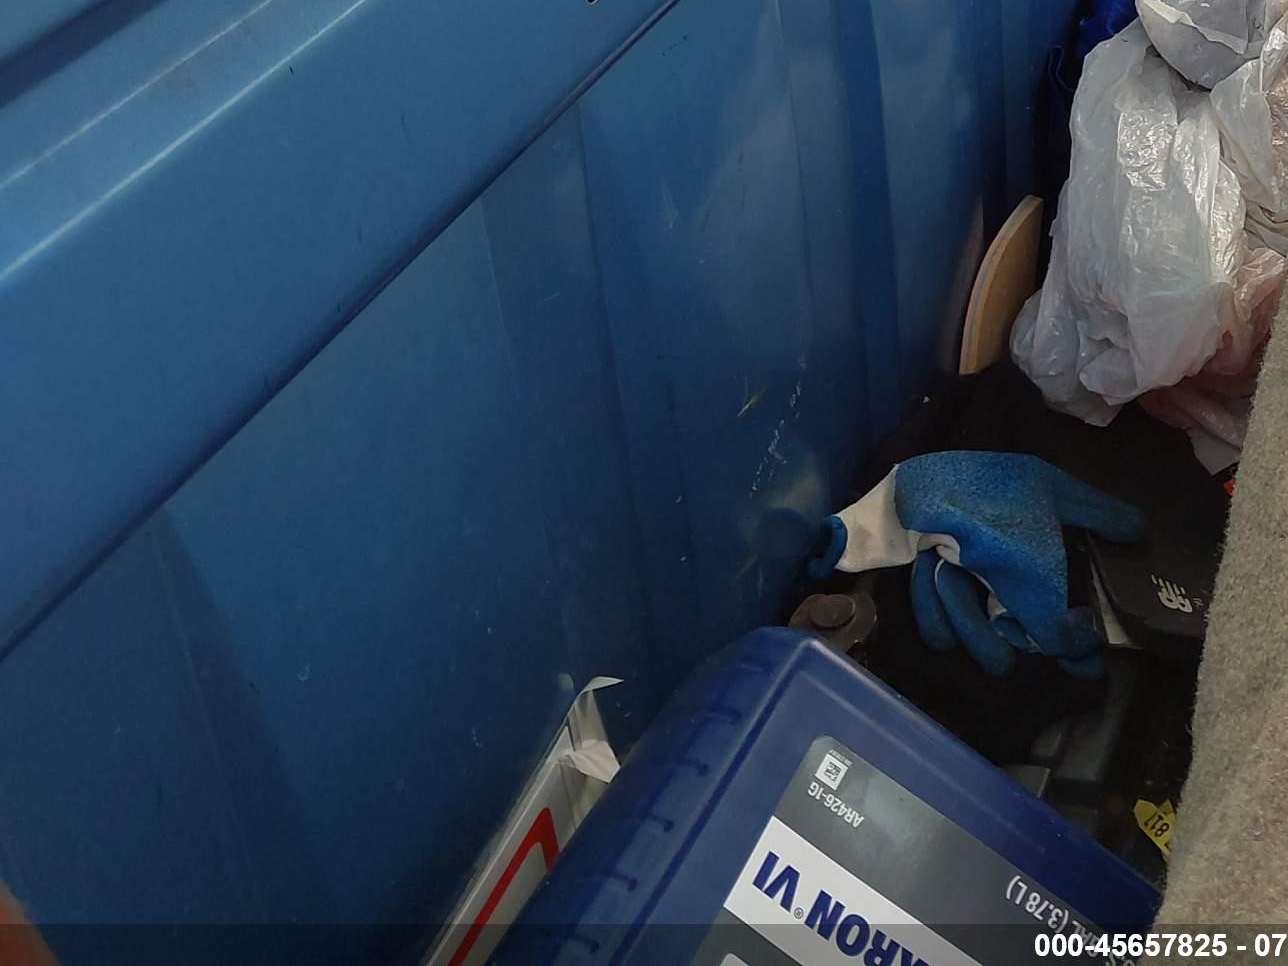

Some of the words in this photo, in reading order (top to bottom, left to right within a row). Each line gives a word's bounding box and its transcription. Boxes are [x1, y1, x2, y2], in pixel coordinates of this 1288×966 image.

[807, 781, 865, 828] AR426-1G
[752, 850, 800, 913] VI
[1006, 875, 1028, 905] L)
[1026, 892, 1069, 934] (3.78
